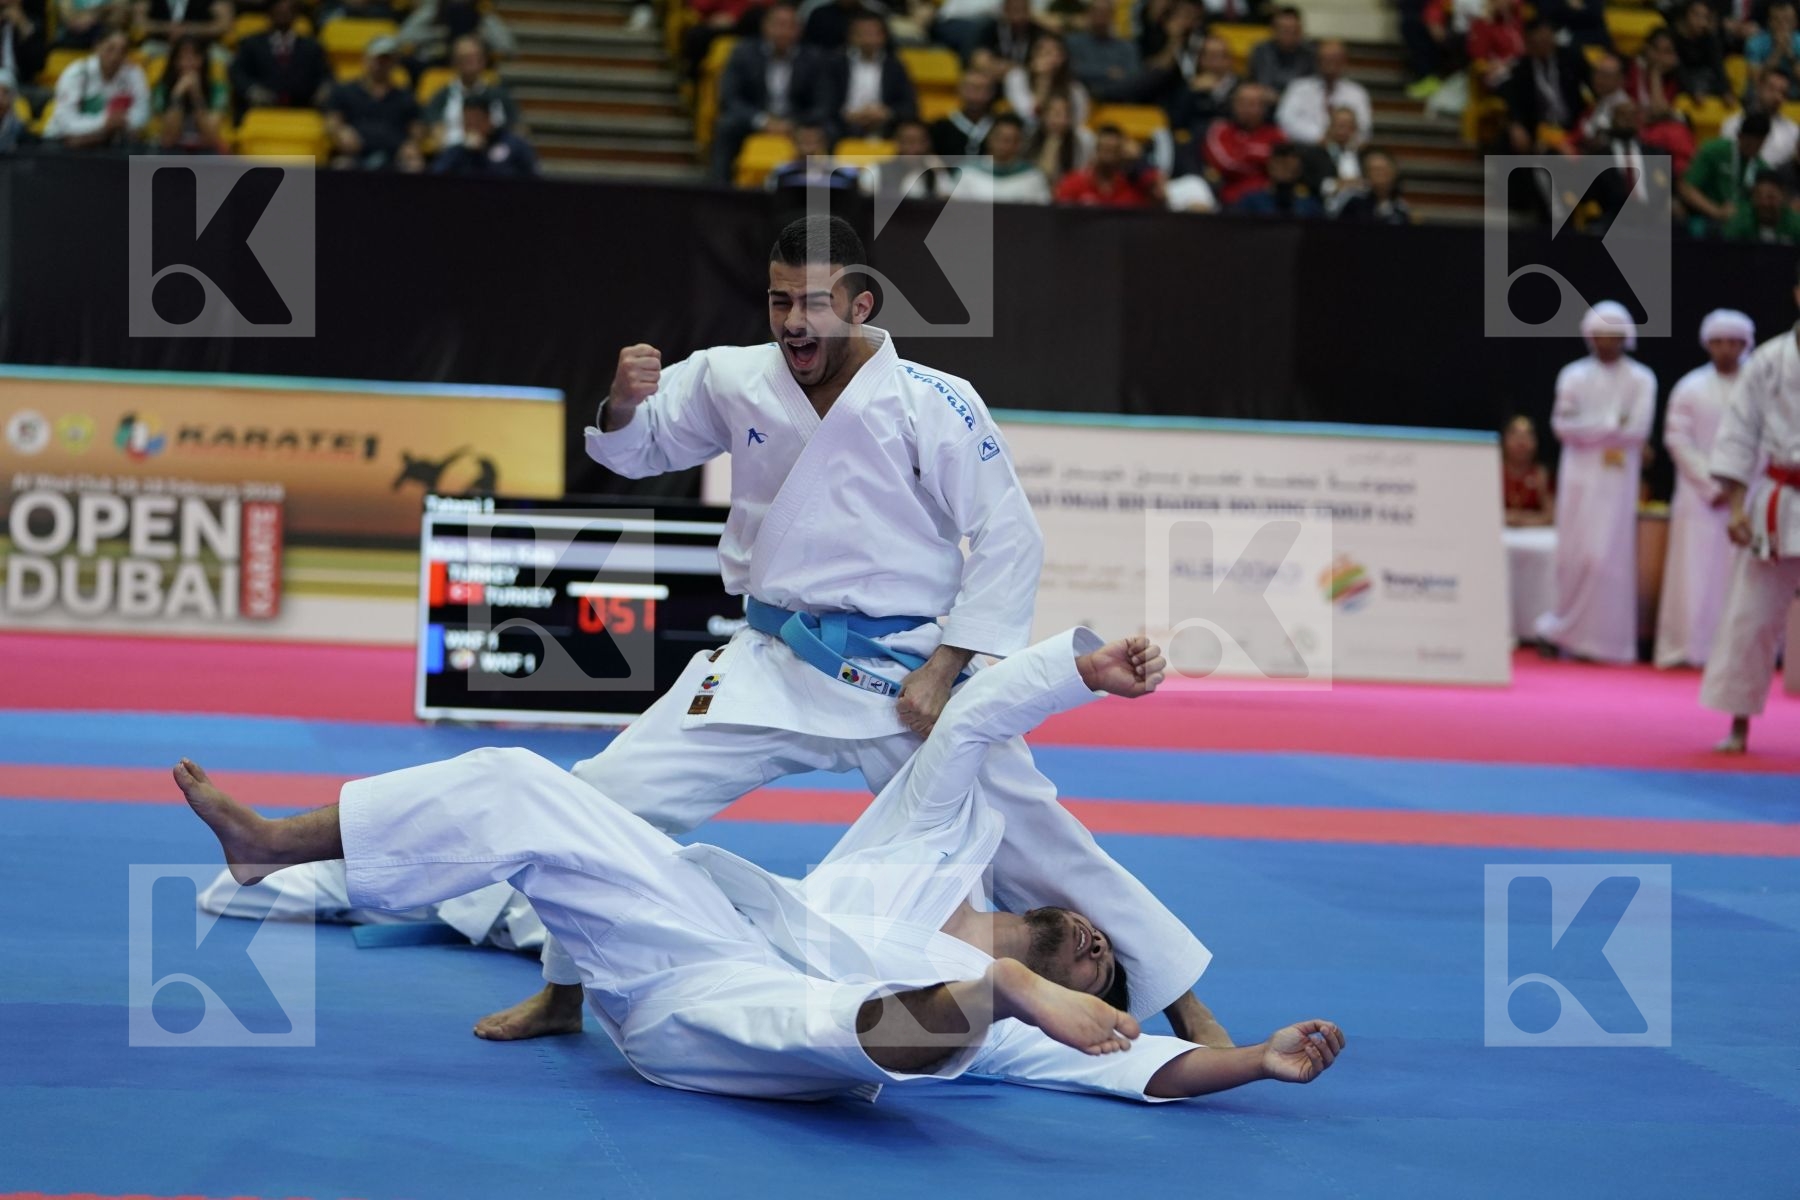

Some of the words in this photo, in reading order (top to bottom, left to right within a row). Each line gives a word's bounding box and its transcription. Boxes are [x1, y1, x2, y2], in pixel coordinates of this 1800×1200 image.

[905, 366, 975, 431] Arawaza
[8, 490, 242, 560] OPEN
[6, 555, 241, 617] DUBAI
[448, 562, 519, 585] TURKEY
[485, 586, 556, 608] TURKEY
